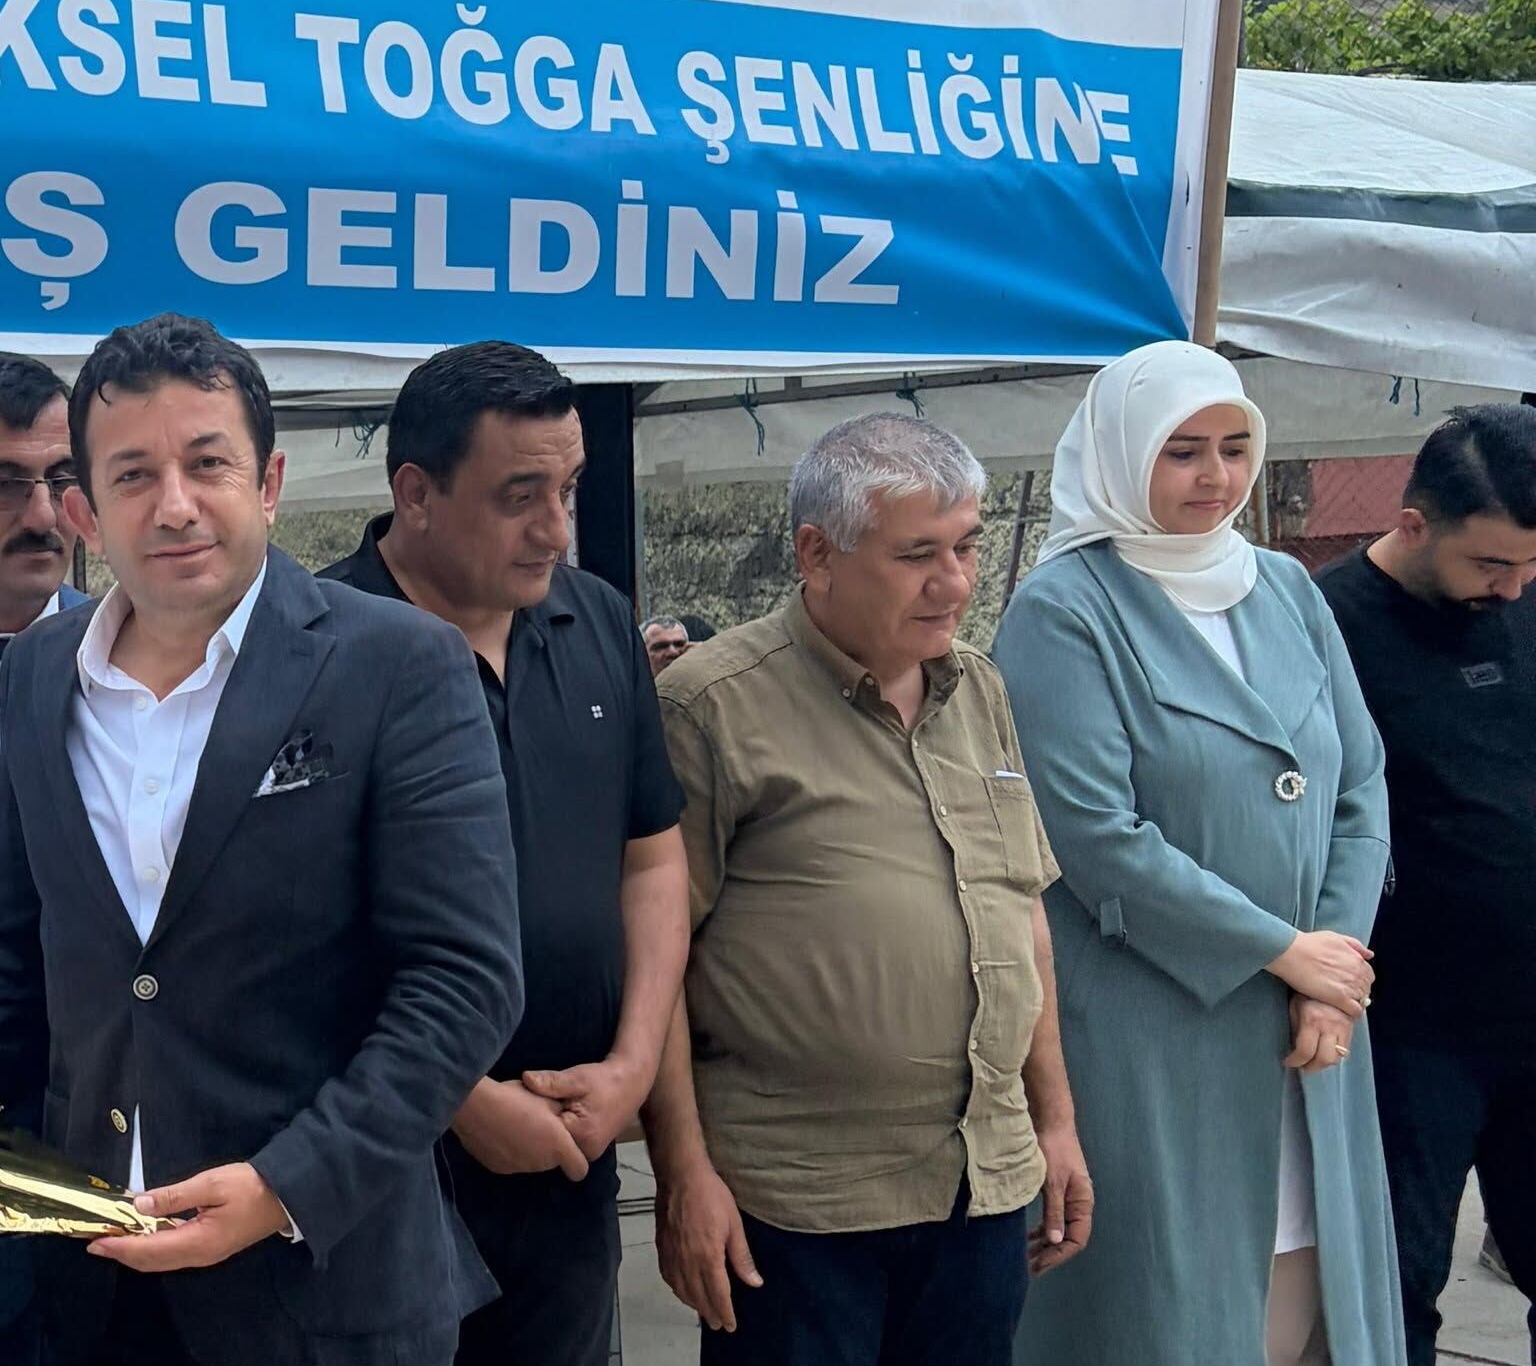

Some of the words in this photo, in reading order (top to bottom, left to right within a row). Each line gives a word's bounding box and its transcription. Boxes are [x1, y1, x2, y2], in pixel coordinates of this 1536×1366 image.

[295, 4, 655, 134] TOĞGA
[677, 50, 1139, 176] ŞENLİĞİNE
[174, 180, 899, 305] GELDİNİZ
